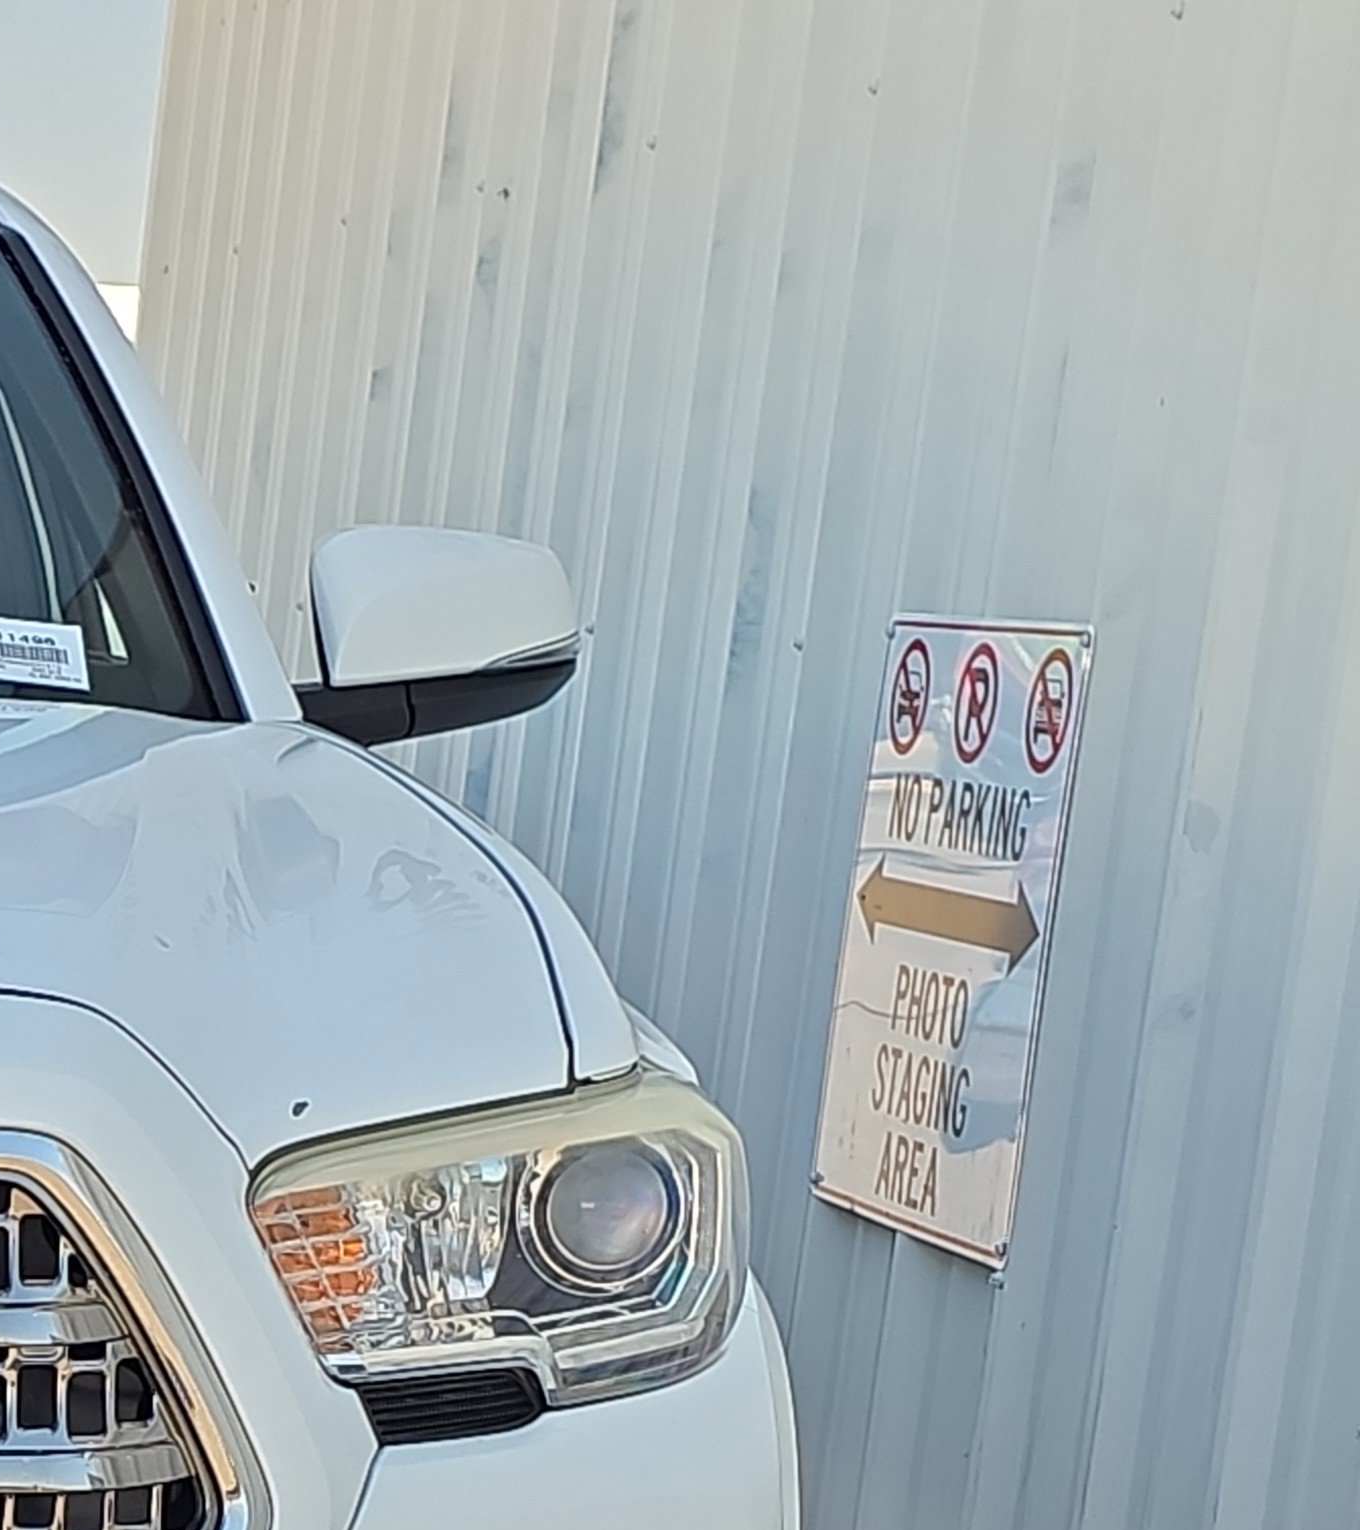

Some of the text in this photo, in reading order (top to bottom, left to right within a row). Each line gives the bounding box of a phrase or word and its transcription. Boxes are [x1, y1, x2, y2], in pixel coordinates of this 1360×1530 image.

[888, 773, 1031, 862] NO PARKING
[891, 964, 969, 1049] PHOTO
[872, 1043, 970, 1138] STAGING
[875, 1131, 938, 1217] AREA
